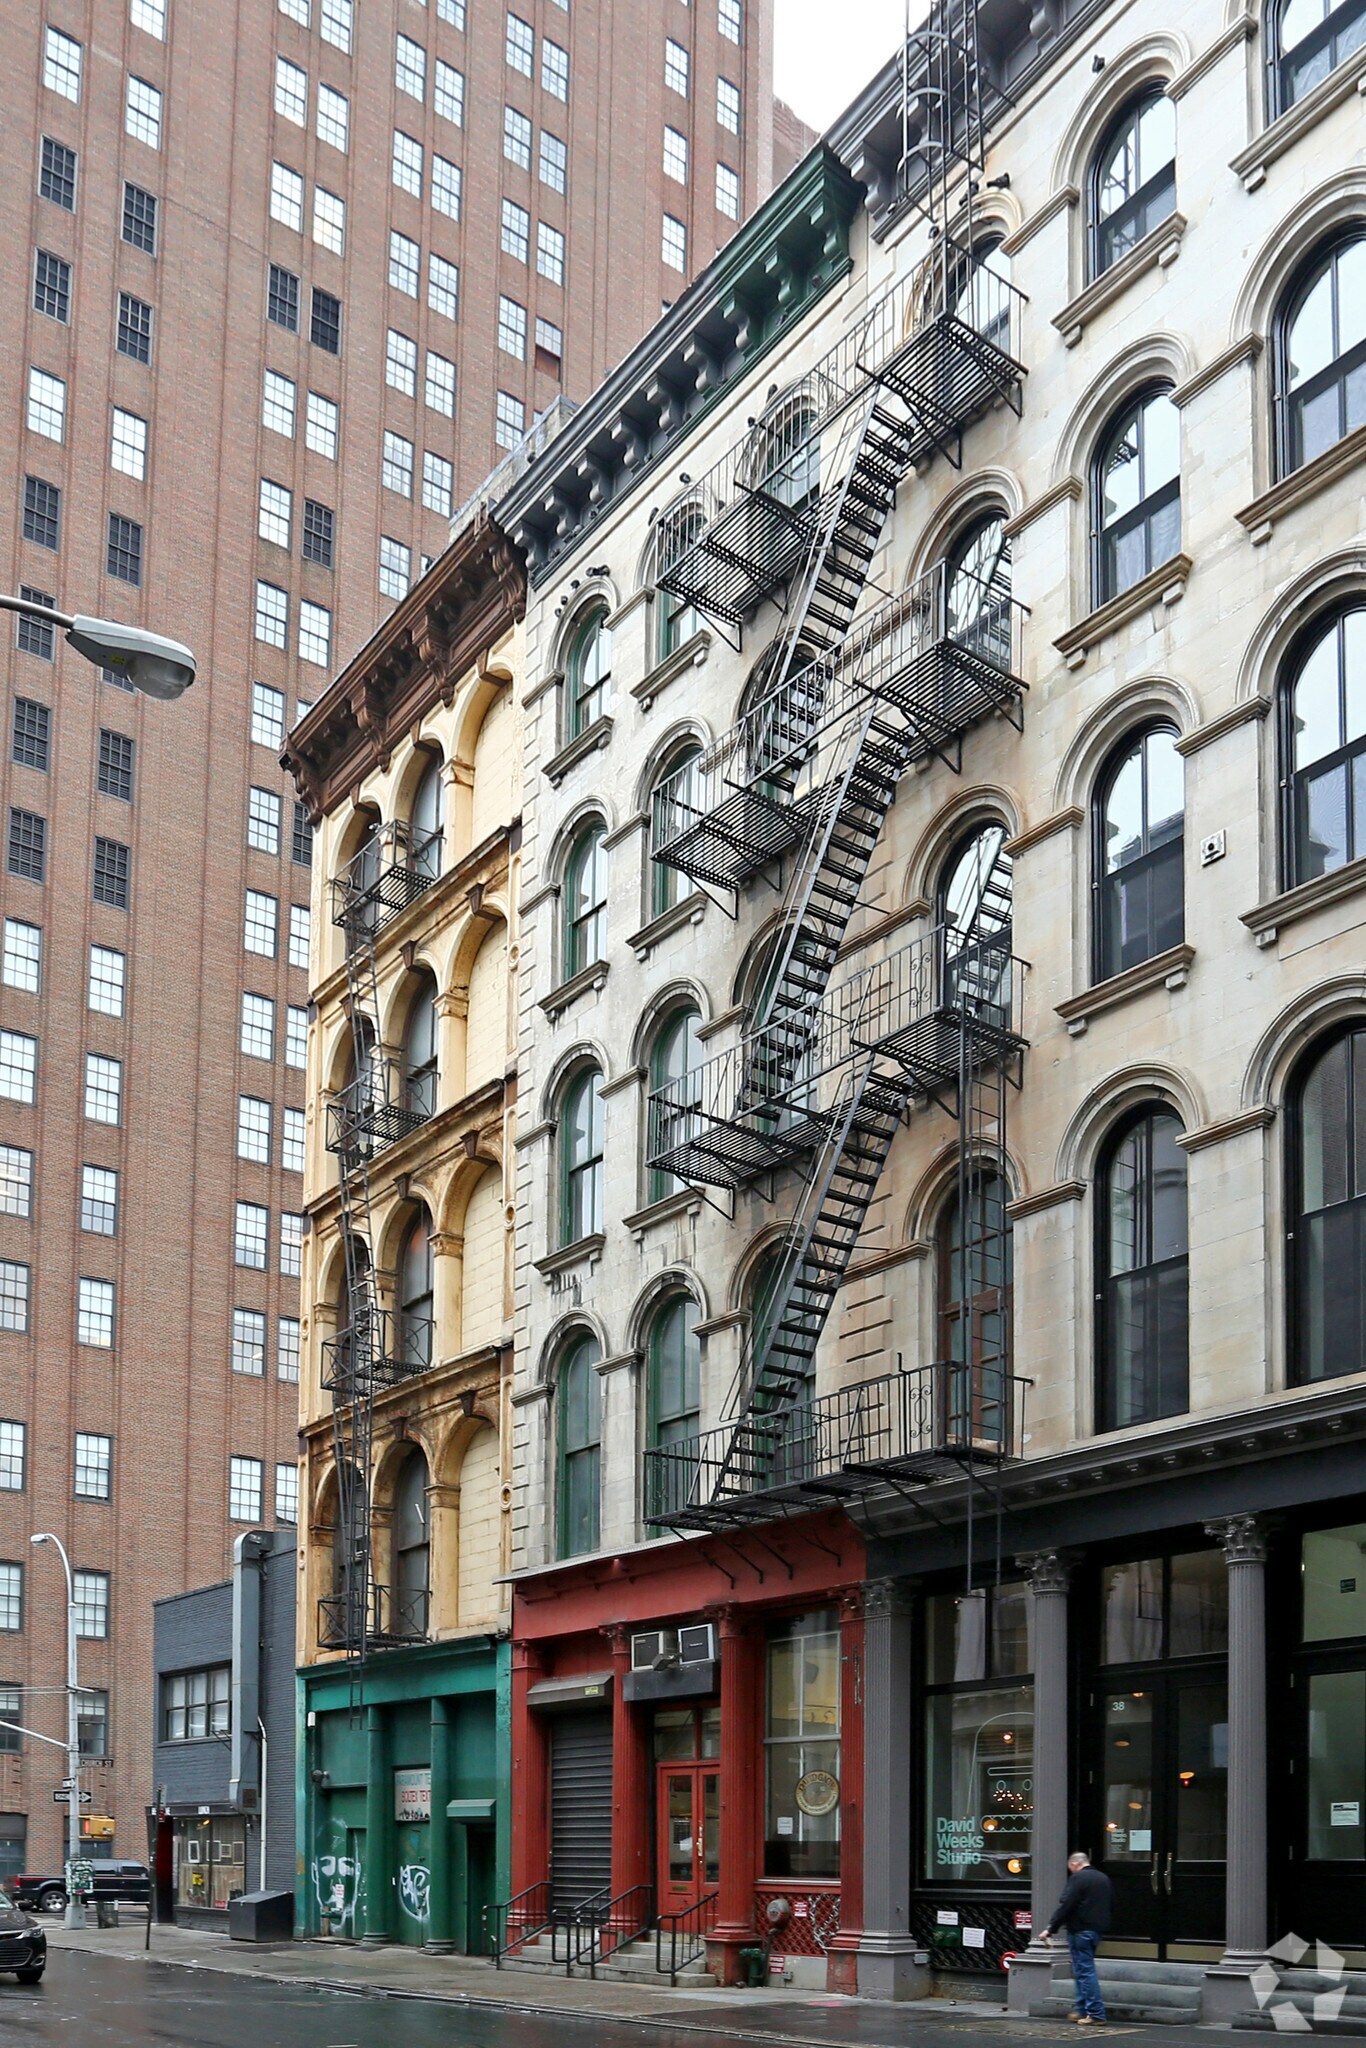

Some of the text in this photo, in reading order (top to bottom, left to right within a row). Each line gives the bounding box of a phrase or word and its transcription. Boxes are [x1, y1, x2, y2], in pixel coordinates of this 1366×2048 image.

[1112, 1701, 1125, 1711] 38
[937, 1816, 975, 1832] David
[937, 1833, 984, 1848] Weeks
[937, 1849, 980, 1865] Studio
